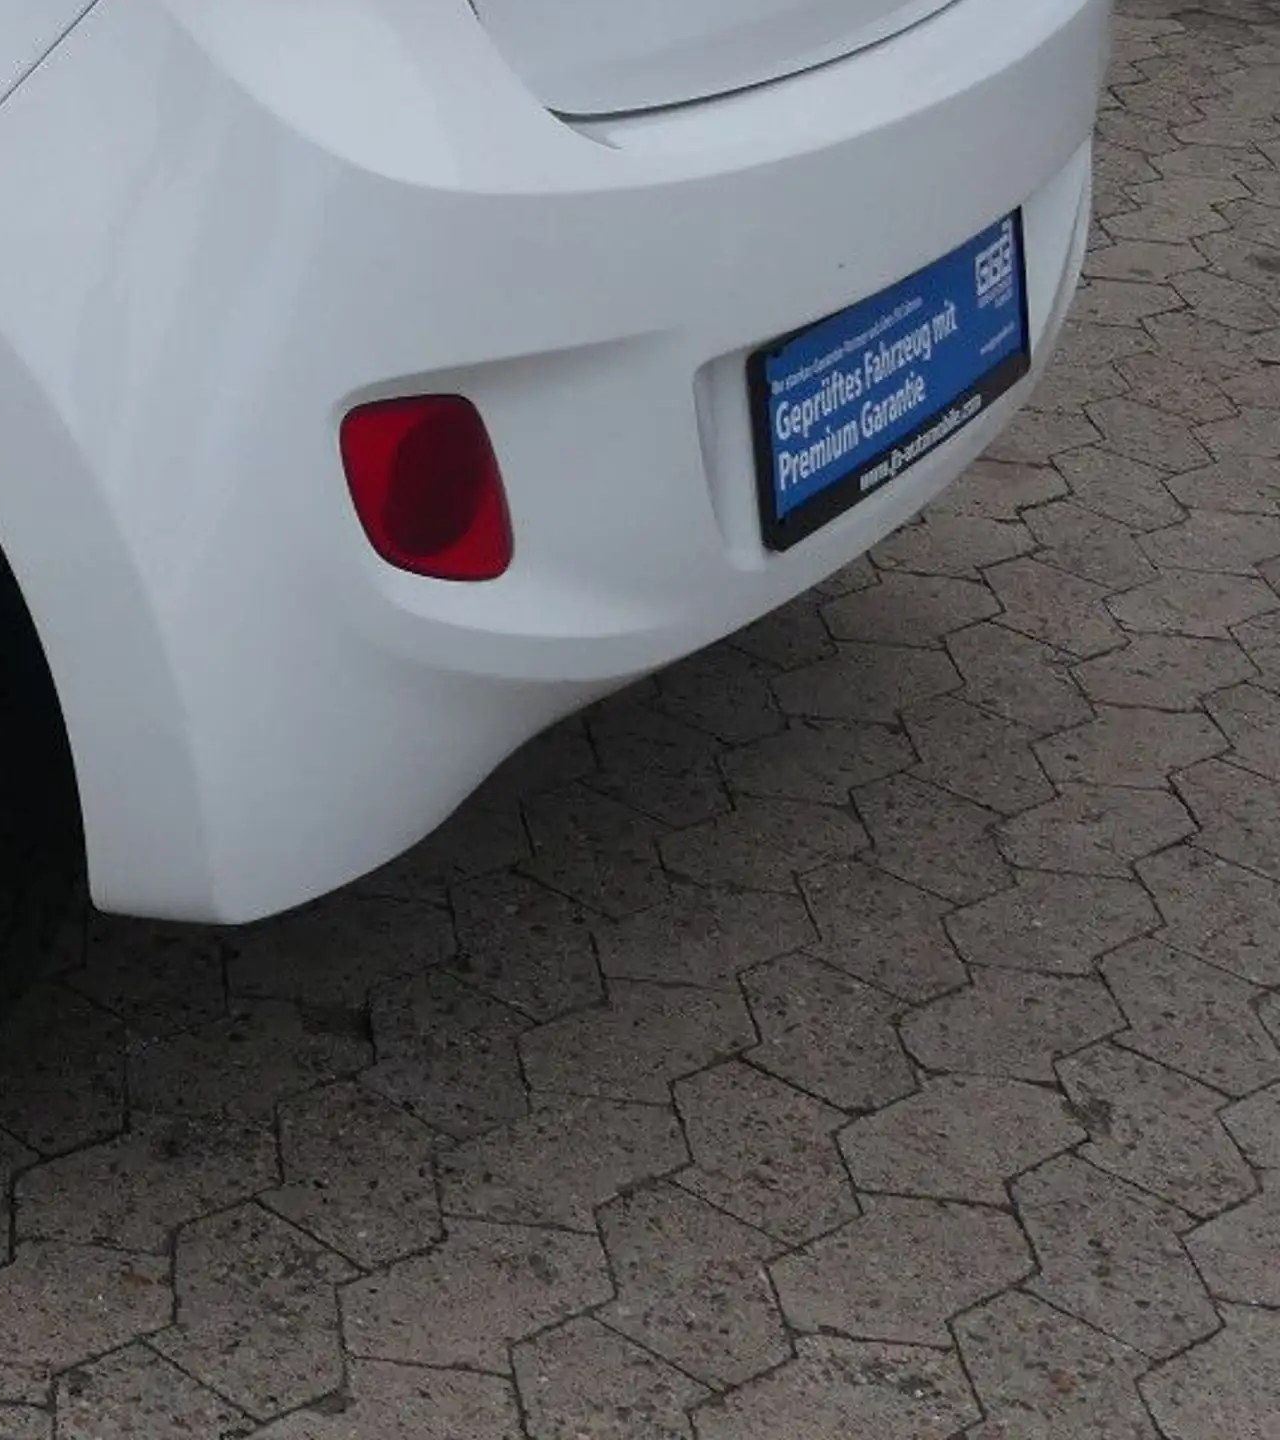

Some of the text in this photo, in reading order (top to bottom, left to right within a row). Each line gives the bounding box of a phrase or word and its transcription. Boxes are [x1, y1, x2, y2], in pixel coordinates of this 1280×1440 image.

[776, 367, 863, 441] Geprüftes
[863, 318, 931, 391] Fahrzeug
[931, 300, 958, 345] mit
[778, 371, 927, 491] Premium Garantie
